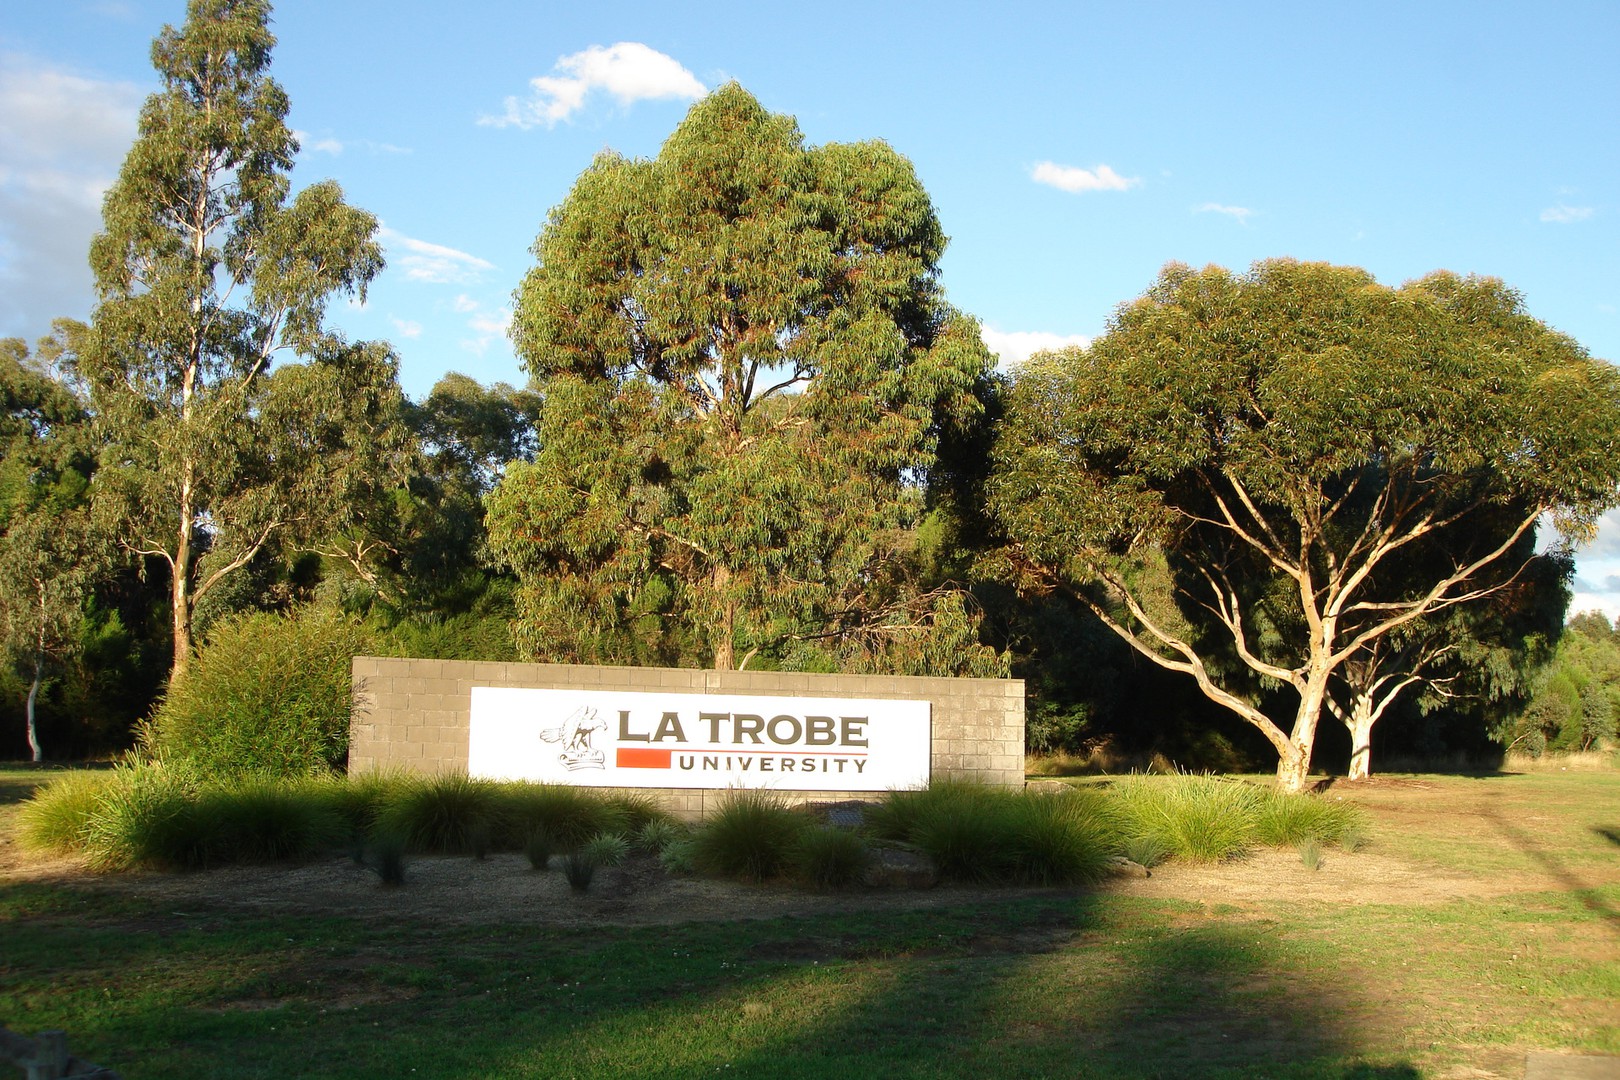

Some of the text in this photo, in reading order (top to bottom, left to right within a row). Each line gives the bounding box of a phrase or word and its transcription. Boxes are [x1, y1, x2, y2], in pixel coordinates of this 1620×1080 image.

[617, 710, 869, 748] LA TROBE
[679, 756, 867, 774] UNIVERSITY
